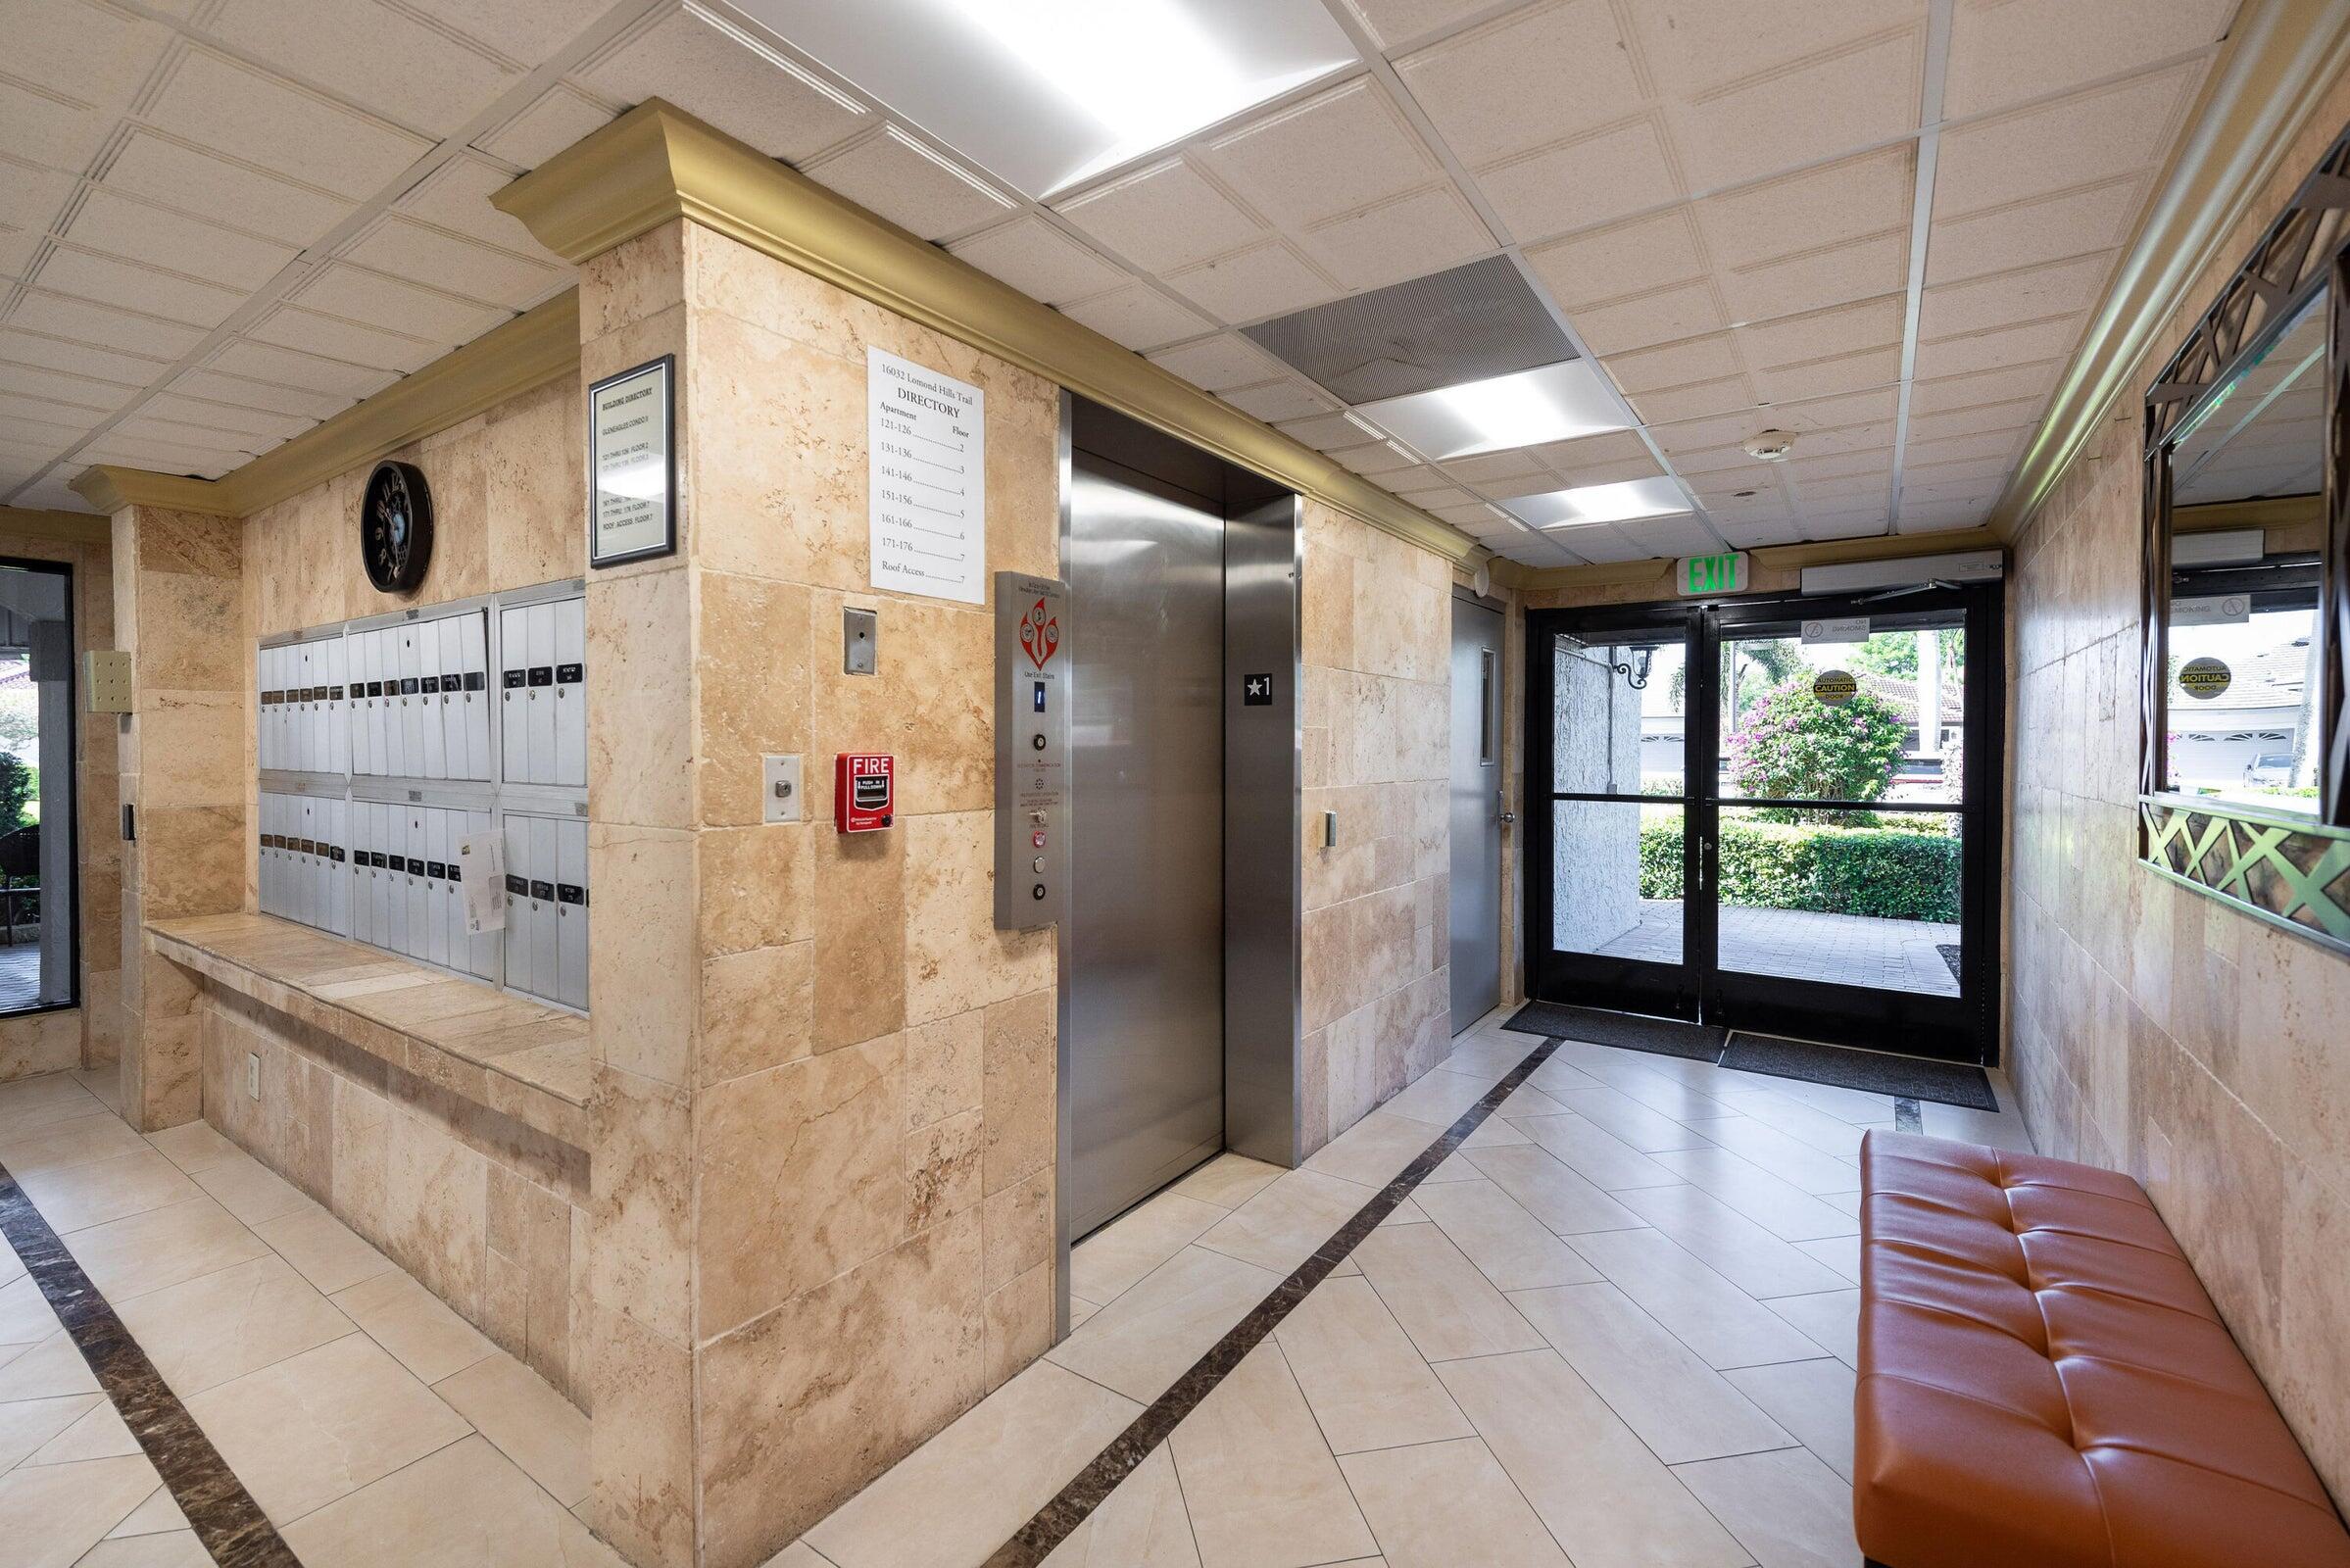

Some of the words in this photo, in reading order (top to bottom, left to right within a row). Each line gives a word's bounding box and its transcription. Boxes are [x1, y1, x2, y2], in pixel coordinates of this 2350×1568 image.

[882, 364, 906, 380] 16032
[906, 373, 938, 392] Lomond
[939, 385, 955, 399] Hills
[956, 391, 973, 406] Trail
[603, 397, 624, 411] BUILDING
[625, 387, 653, 403] DIRECTORY
[880, 401, 916, 420] Apartment
[898, 387, 960, 418] DIRECTORY
[881, 417, 912, 436] 121-126
[959, 443, 964, 453] 2
[952, 425, 969, 438] Floor
[881, 441, 912, 459] 131-136
[959, 466, 965, 475] 3
[881, 466, 913, 482] 141-146
[959, 488, 965, 497] 4
[881, 489, 912, 505] 151-156
[959, 510, 965, 518] 5
[881, 514, 913, 528] 161-166
[959, 532, 965, 541] 6
[882, 537, 913, 552] 171-176
[959, 554, 965, 563] 7
[882, 560, 901, 572] Roof
[902, 564, 925, 577] Access
[1689, 554, 1740, 593] EXIT
[1264, 676, 1270, 696] 1
[854, 758, 890, 774] FIRE
